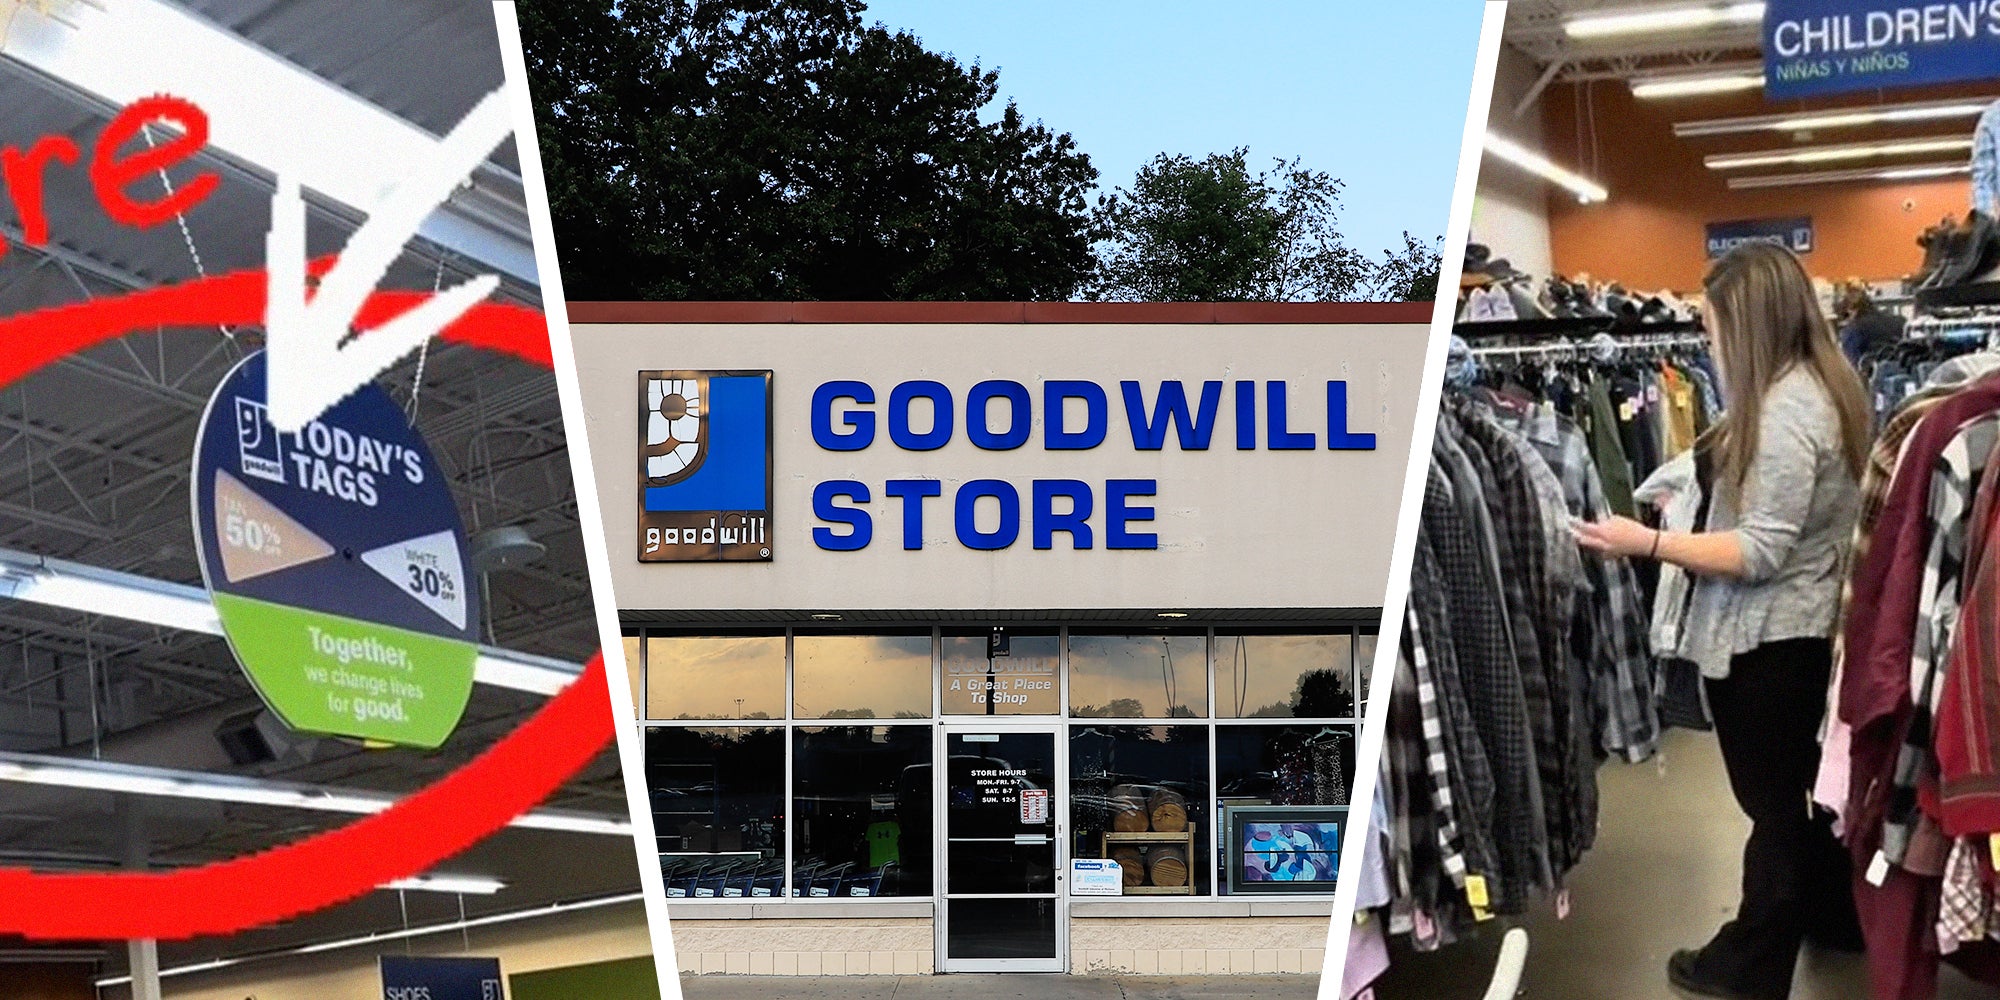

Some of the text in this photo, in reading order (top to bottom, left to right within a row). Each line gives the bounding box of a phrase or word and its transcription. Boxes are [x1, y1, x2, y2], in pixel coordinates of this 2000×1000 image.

[1776, 51, 1909, 80] NIÑAS Y NIÑOS
[810, 380, 1376, 451] GOODWILL
[290, 451, 378, 507] TAGS
[811, 478, 1158, 551] STORE
[226, 514, 281, 551] 50%
[646, 517, 765, 554] goodwill
[405, 547, 439, 569] WHITE
[408, 563, 455, 597] 30%
[308, 626, 414, 671] Together,
[947, 657, 1053, 673] GOODWILL
[304, 665, 424, 700] we change lives
[950, 679, 1052, 691] A Great Place
[328, 692, 409, 722] for good.
[971, 692, 1028, 706] To Shop
[971, 769, 1027, 777] STORE HOURS
[386, 986, 432, 1000] SHOES
